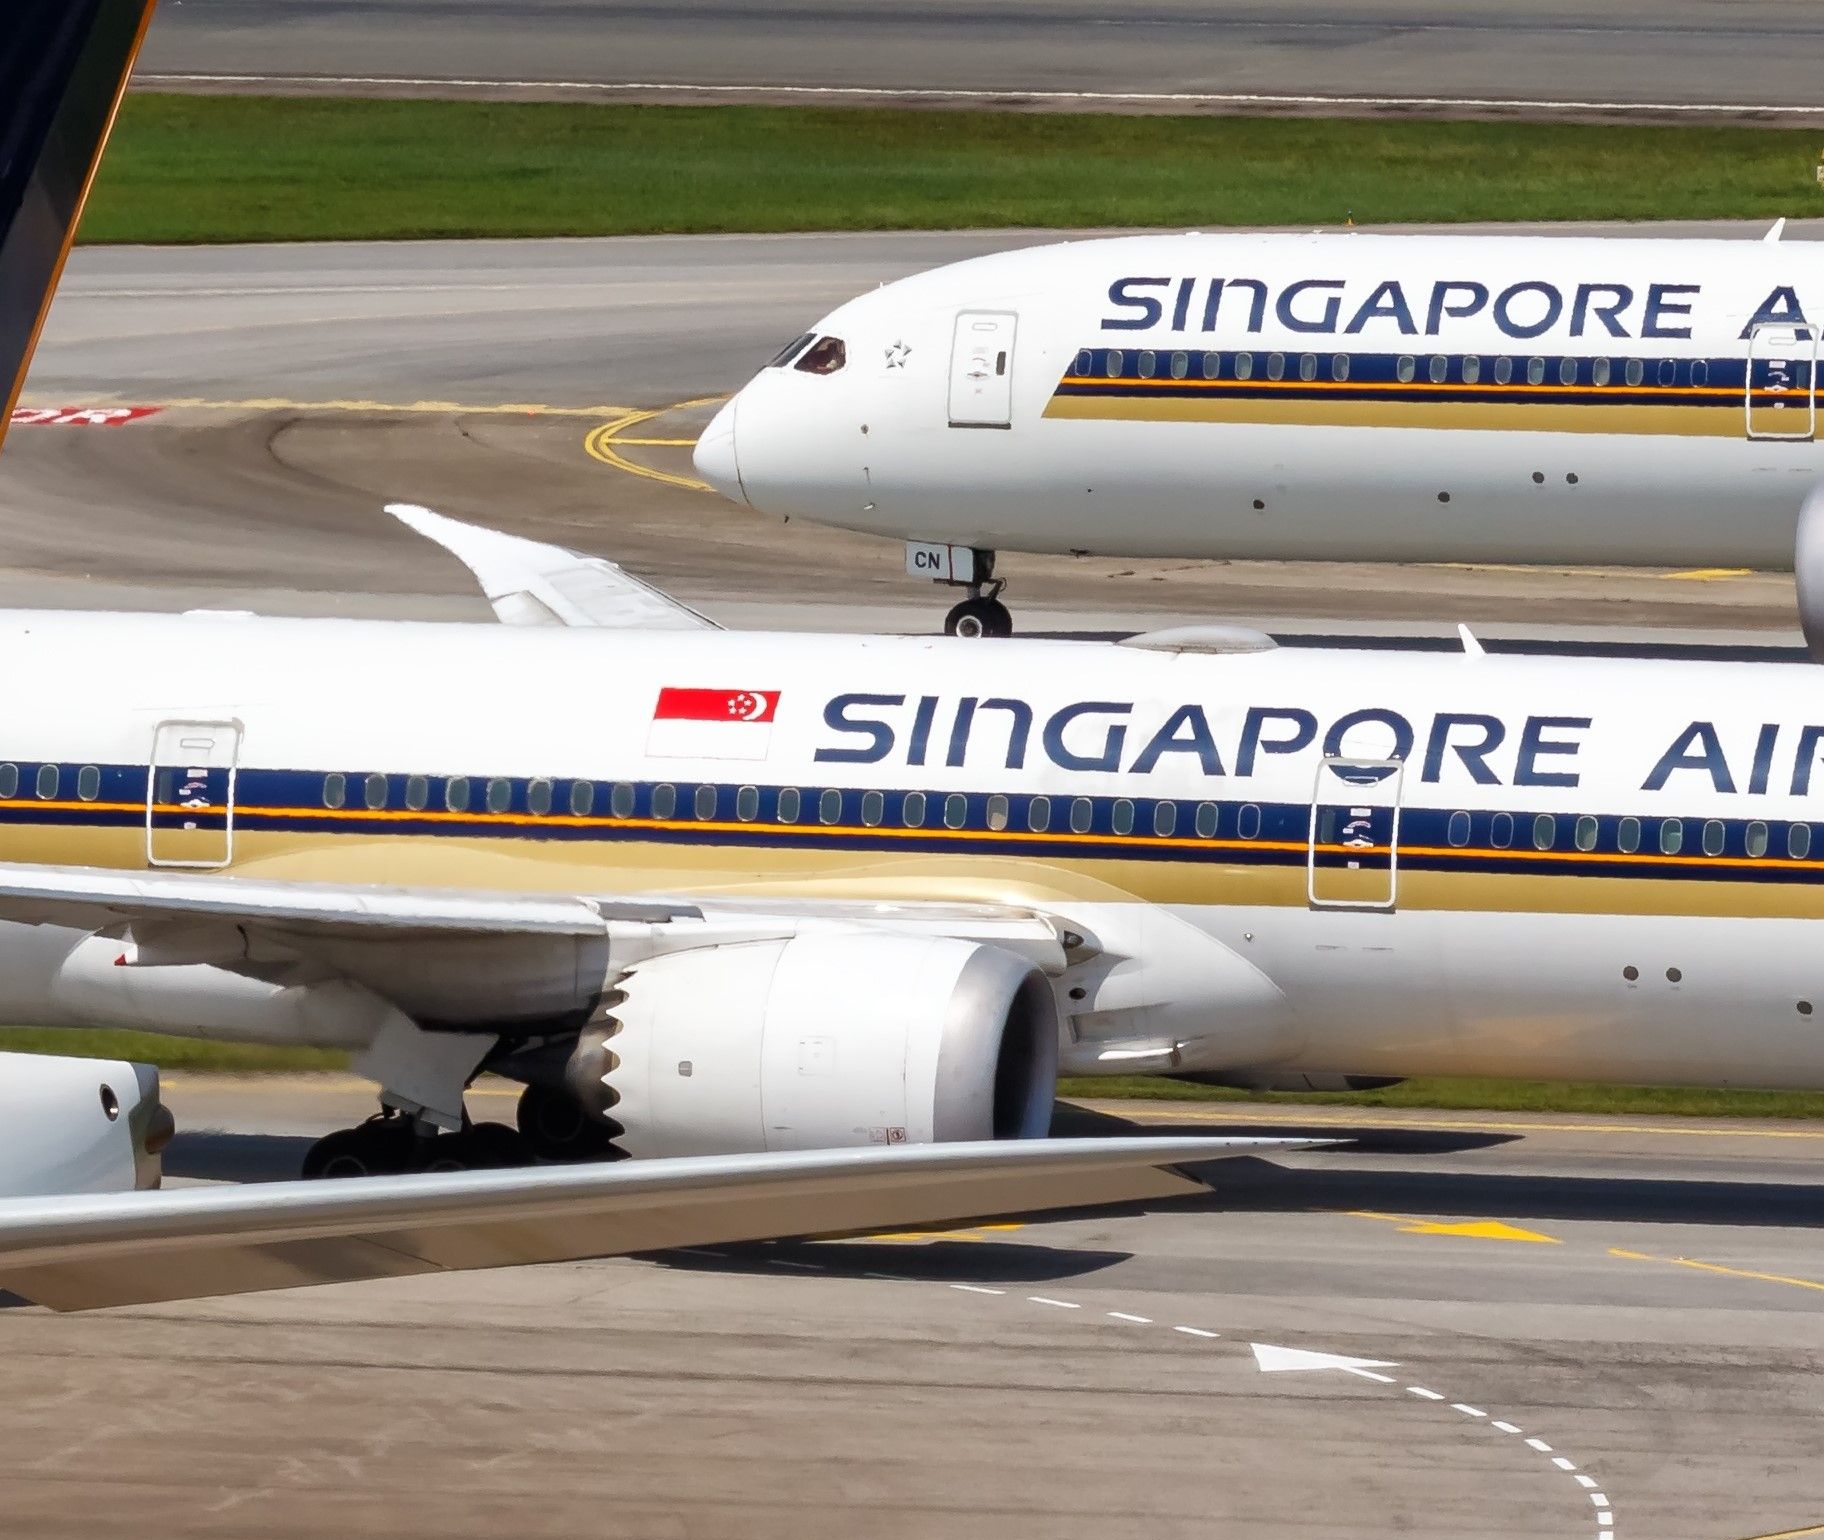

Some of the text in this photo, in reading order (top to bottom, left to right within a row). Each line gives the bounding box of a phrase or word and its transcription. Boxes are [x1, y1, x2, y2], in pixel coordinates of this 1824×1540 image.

[1101, 277, 1696, 339] SINGAPORE
[914, 550, 941, 570] CN
[814, 693, 1592, 787] SINGAPORE
